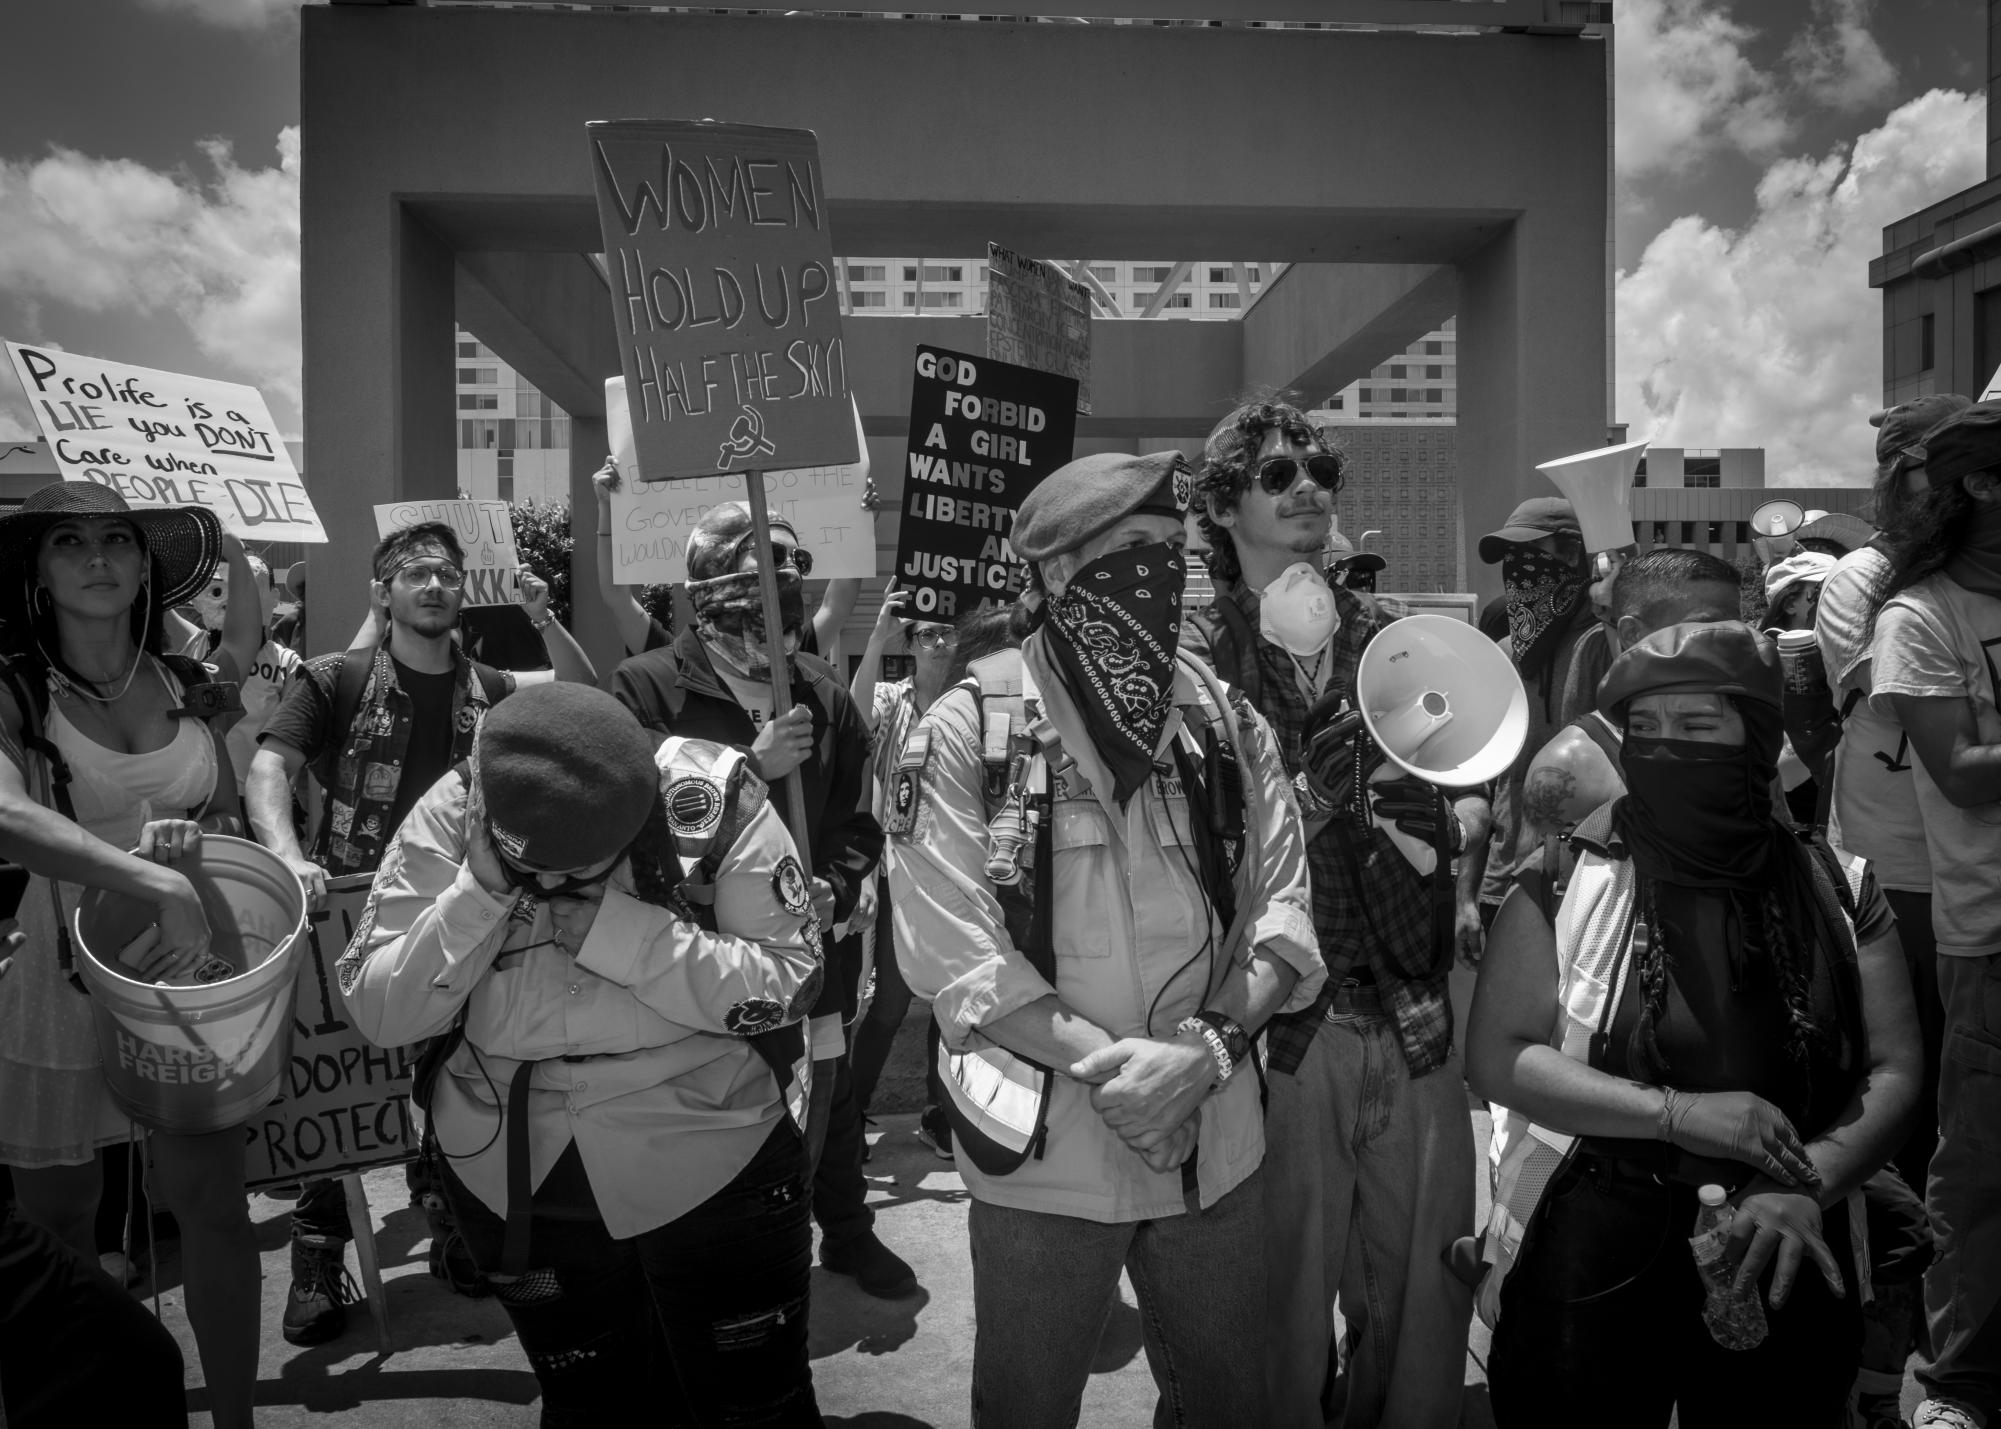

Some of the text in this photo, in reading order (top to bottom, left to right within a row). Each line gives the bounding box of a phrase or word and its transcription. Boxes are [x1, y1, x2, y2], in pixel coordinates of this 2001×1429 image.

[596, 139, 821, 236] WOMEN
[619, 247, 830, 336] HOLD UP
[18, 348, 251, 425] Prolife is a
[635, 337, 847, 423] HALF THE SKY!
[916, 352, 977, 386] GOD
[40, 399, 114, 432] LIE
[128, 417, 187, 443] you
[945, 390, 1046, 433] FORBID
[56, 439, 219, 476] Care when
[925, 422, 1032, 466] A GIRL
[909, 452, 1006, 494] WANTS
[83, 468, 314, 527] PEOPLE DIE
[819, 526, 852, 545] IT
[979, 534, 1028, 565] AN
[904, 551, 1023, 594] JUSTICE
[899, 583, 957, 617] FOR
[1155, 779, 1183, 797] BROW
